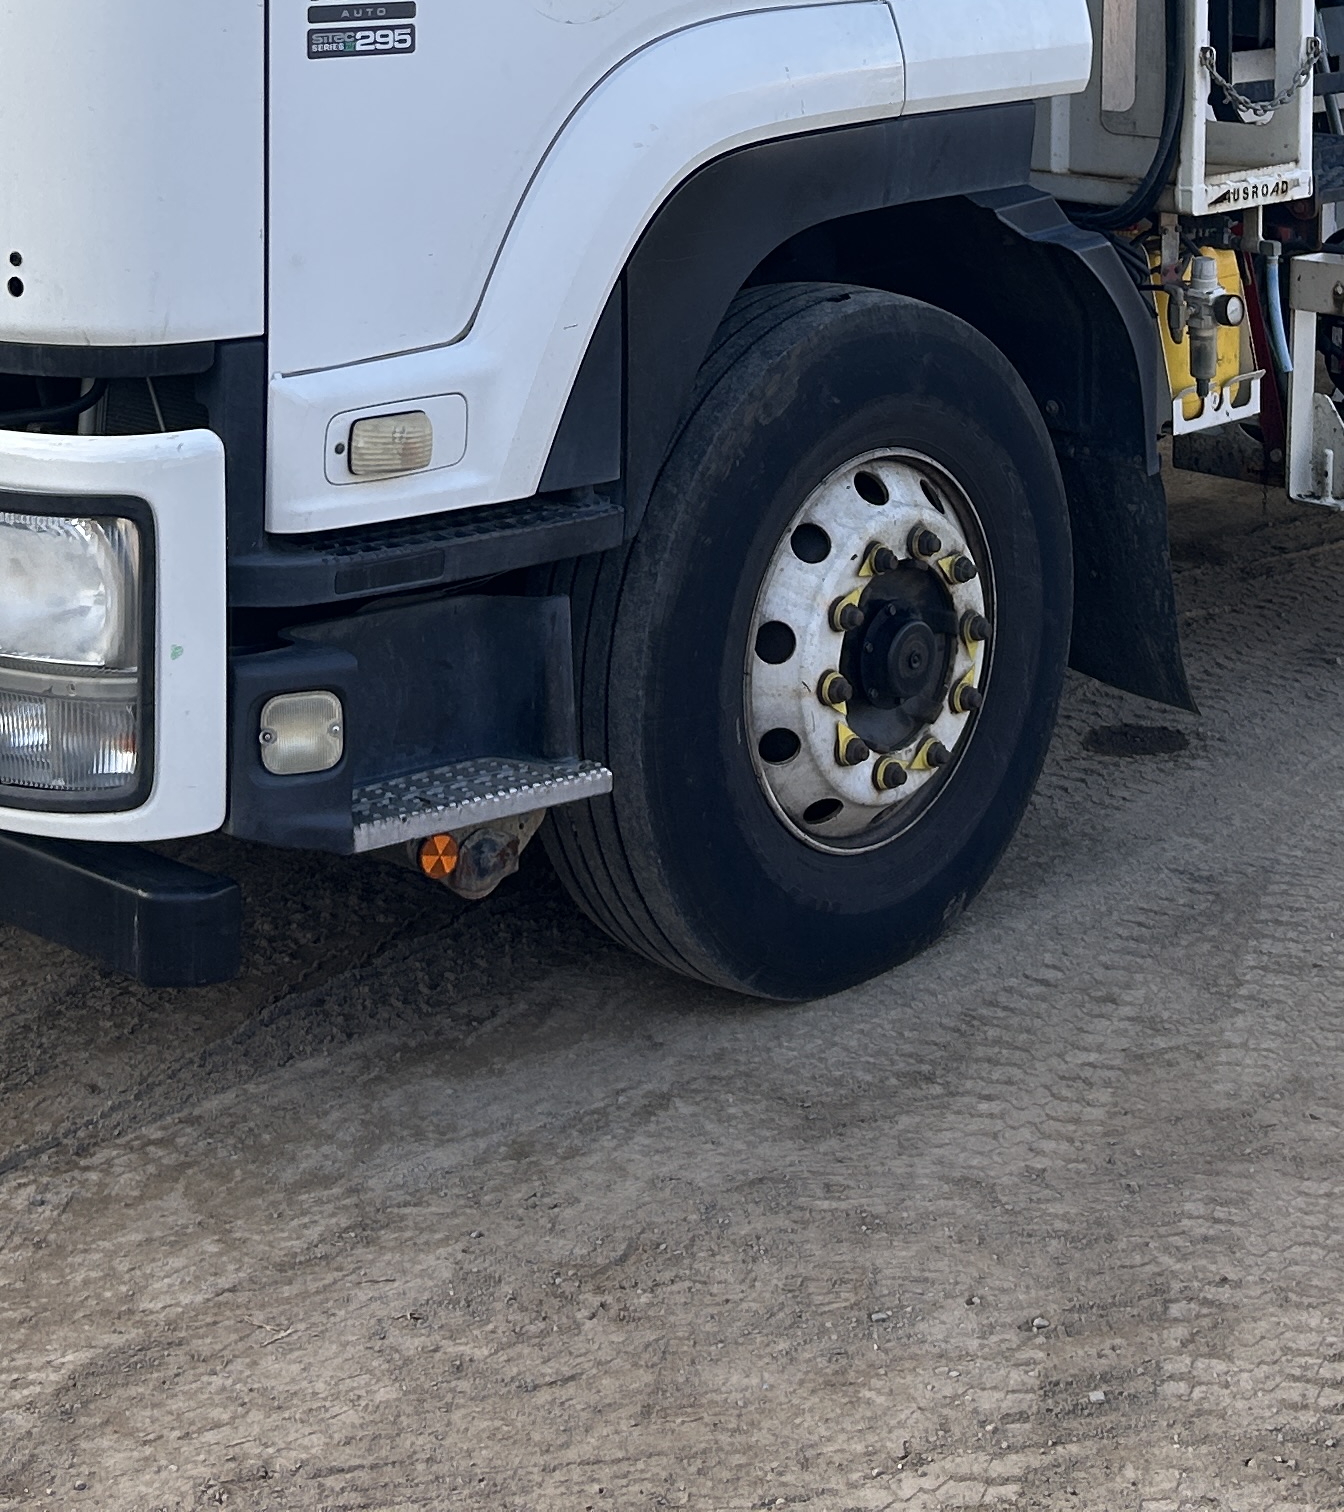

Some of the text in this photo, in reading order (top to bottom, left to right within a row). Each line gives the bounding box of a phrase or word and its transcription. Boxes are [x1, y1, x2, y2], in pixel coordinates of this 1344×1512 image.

[340, 7, 387, 19] AUTO
[355, 28, 412, 51] 295
[1207, 180, 1289, 207] AUSROAD
